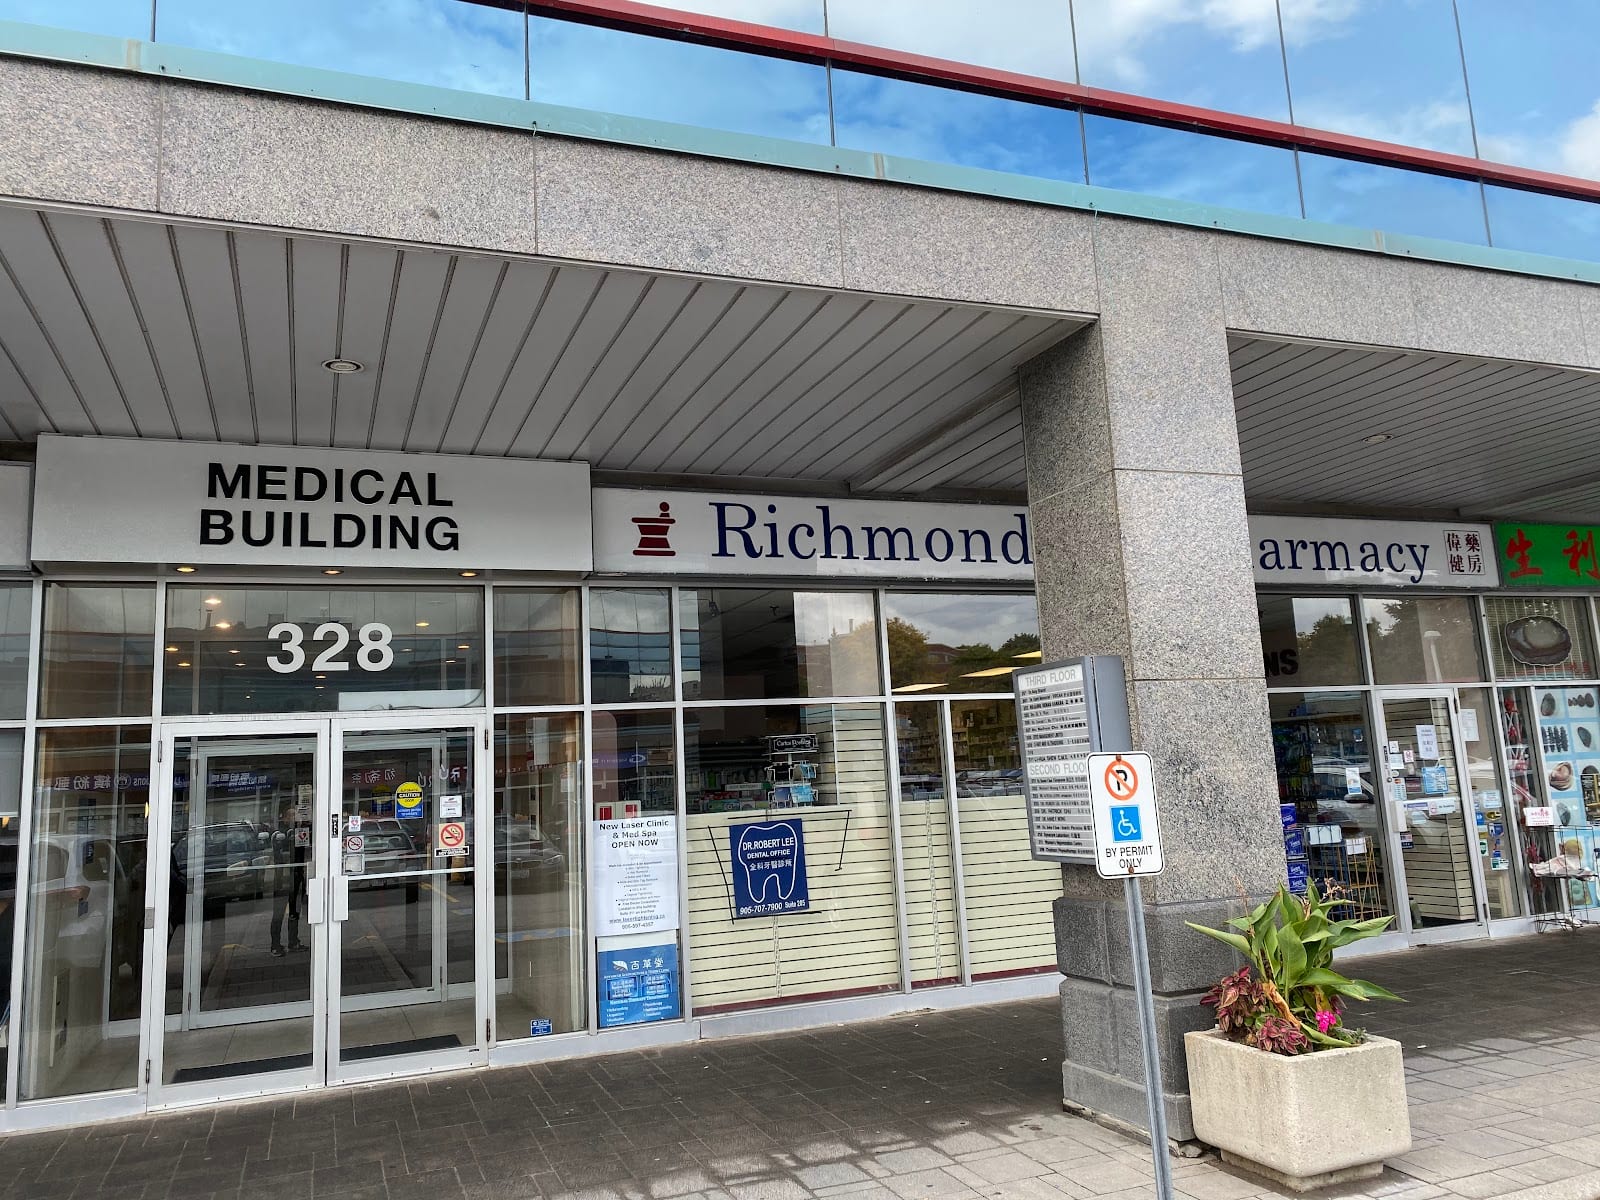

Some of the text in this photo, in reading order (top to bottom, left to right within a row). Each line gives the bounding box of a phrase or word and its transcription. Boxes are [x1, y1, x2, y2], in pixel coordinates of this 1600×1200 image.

[207, 462, 454, 508] MEDICAL
[199, 509, 460, 552] BUILDING
[708, 501, 1430, 584] Richmond armacy
[266, 622, 395, 673] 328
[1025, 669, 1076, 687] THIRD FLOOR
[1029, 762, 1088, 776] SECOND FLOO
[599, 820, 670, 831] New Laser Clinic
[641, 830, 657, 838] Spa
[611, 838, 659, 849] OPEN NOW
[781, 837, 795, 847] LEE
[770, 849, 791, 857] OFFICE
[1105, 847, 1117, 858] BY
[1120, 845, 1154, 857] PERMIT
[1119, 858, 1142, 869] ONLY
